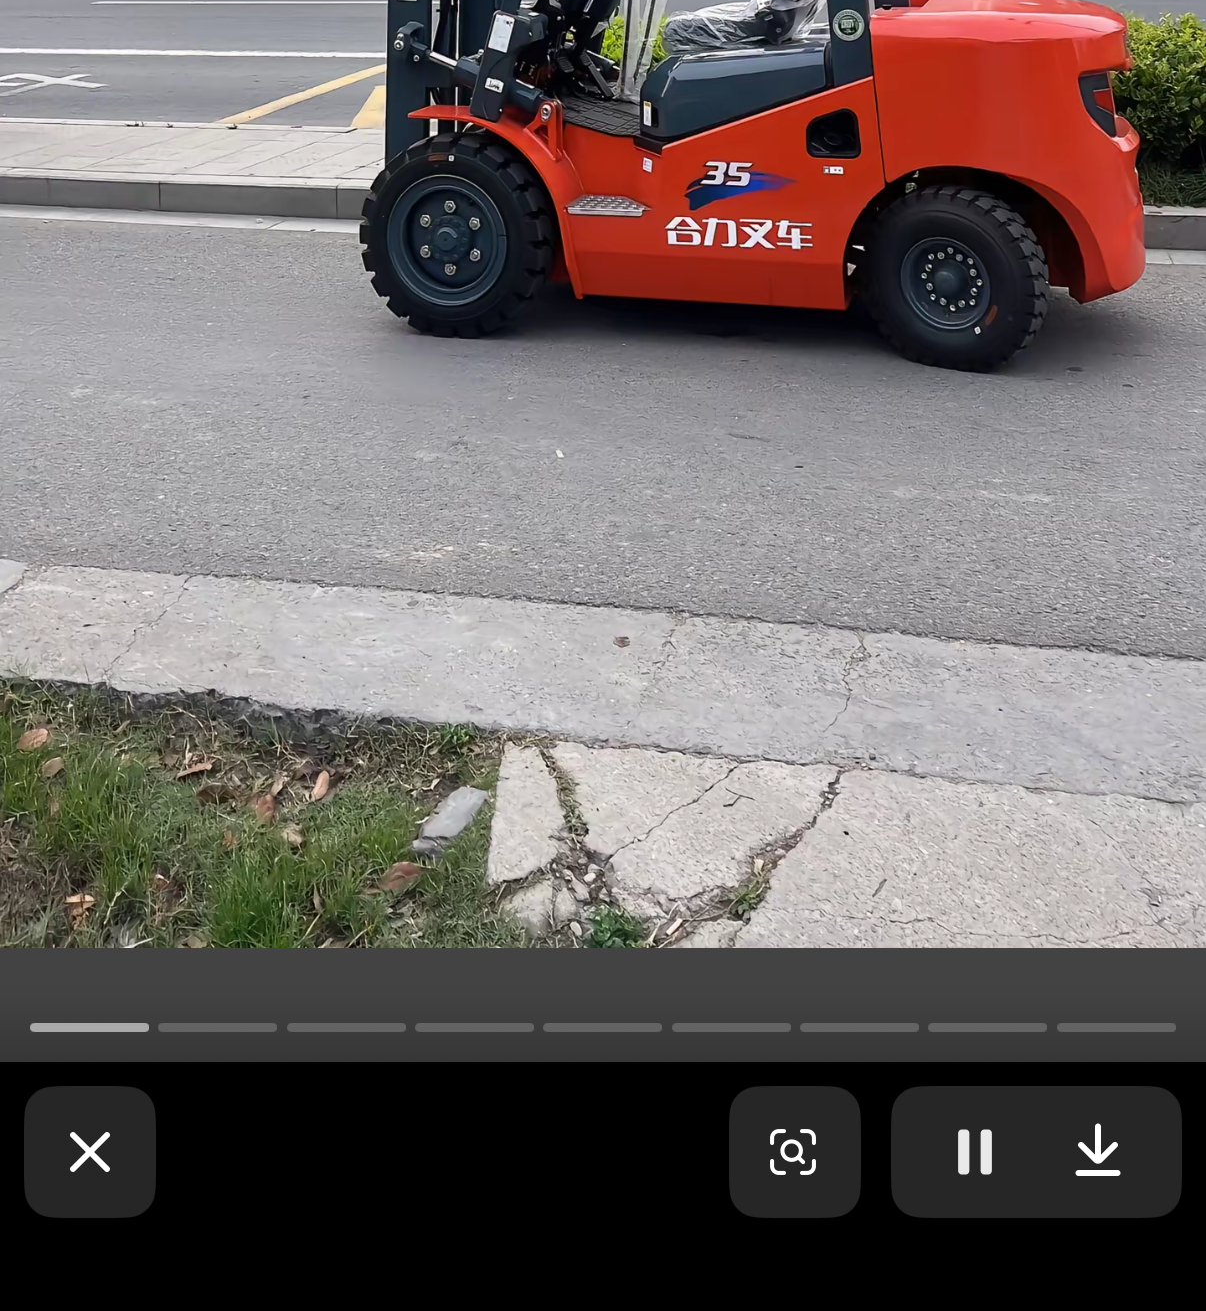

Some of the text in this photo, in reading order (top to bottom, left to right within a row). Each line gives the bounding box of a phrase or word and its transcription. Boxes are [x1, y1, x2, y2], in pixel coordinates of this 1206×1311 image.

[700, 160, 753, 187] 35
[665, 216, 813, 250] 合力叉车
